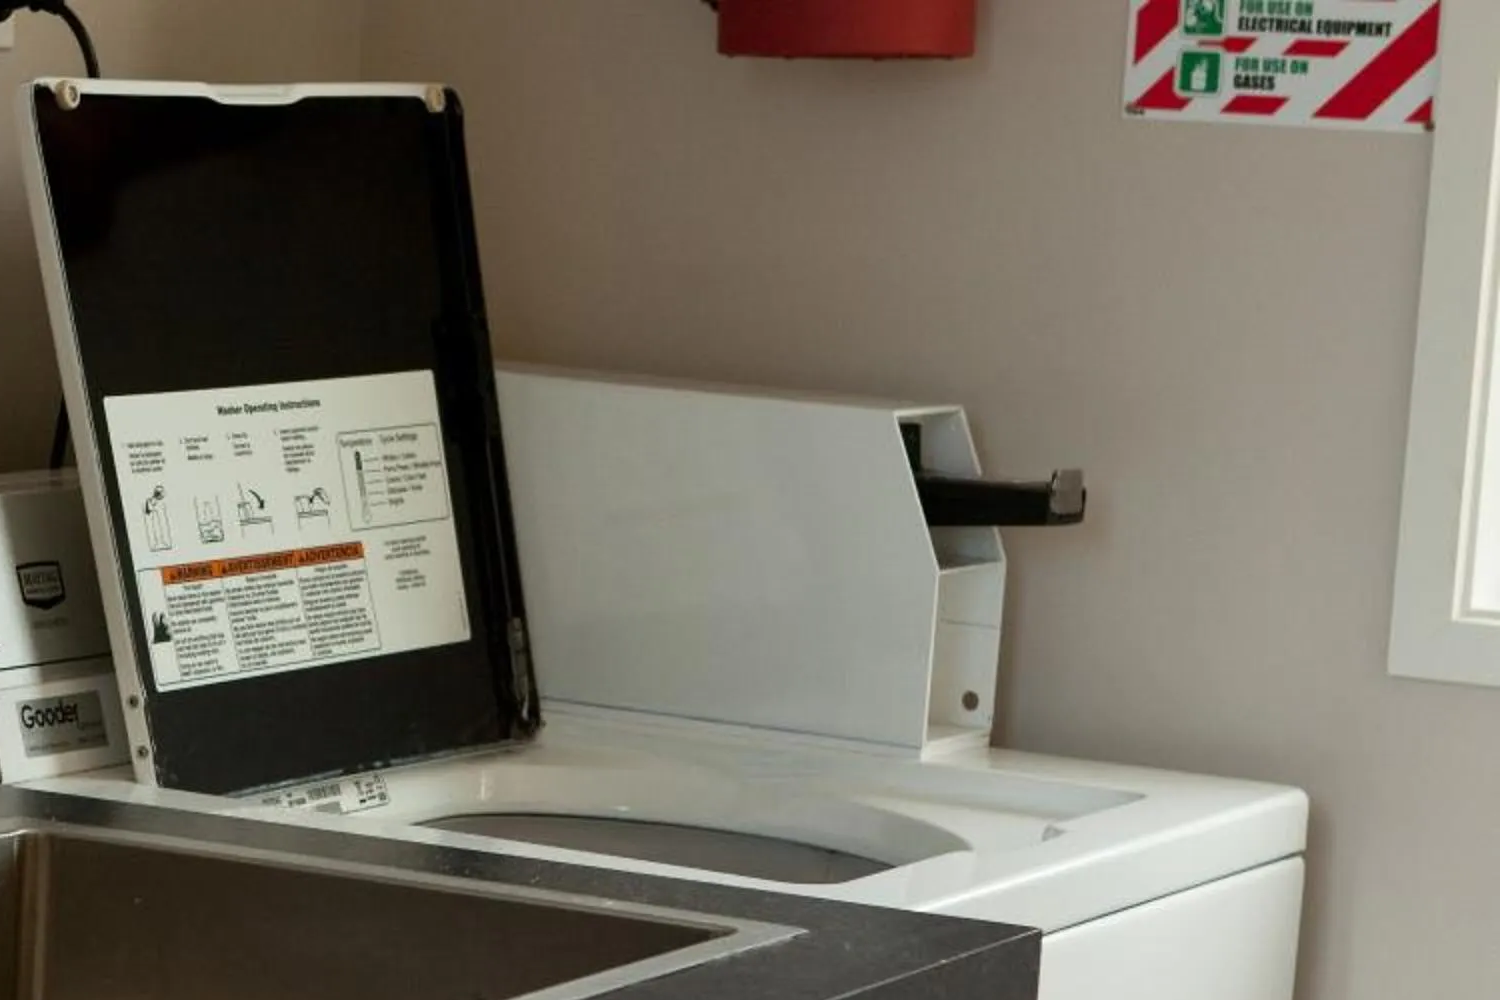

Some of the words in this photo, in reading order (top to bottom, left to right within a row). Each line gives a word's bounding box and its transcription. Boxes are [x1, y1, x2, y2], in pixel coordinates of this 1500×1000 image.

[1239, 0, 1263, 13] FOR
[1267, 0, 1291, 15] USE
[1295, 1, 1313, 16] ON
[1238, 16, 1313, 33] ELECTRICAL
[1316, 19, 1392, 36] EQUIPMENT
[1235, 57, 1259, 71] FOR
[1263, 58, 1286, 73] USE
[1290, 60, 1309, 74] ON
[1233, 74, 1275, 90] GASES
[217, 405, 242, 415] Washer
[243, 402, 278, 414] Operating
[280, 400, 321, 410] Instructions
